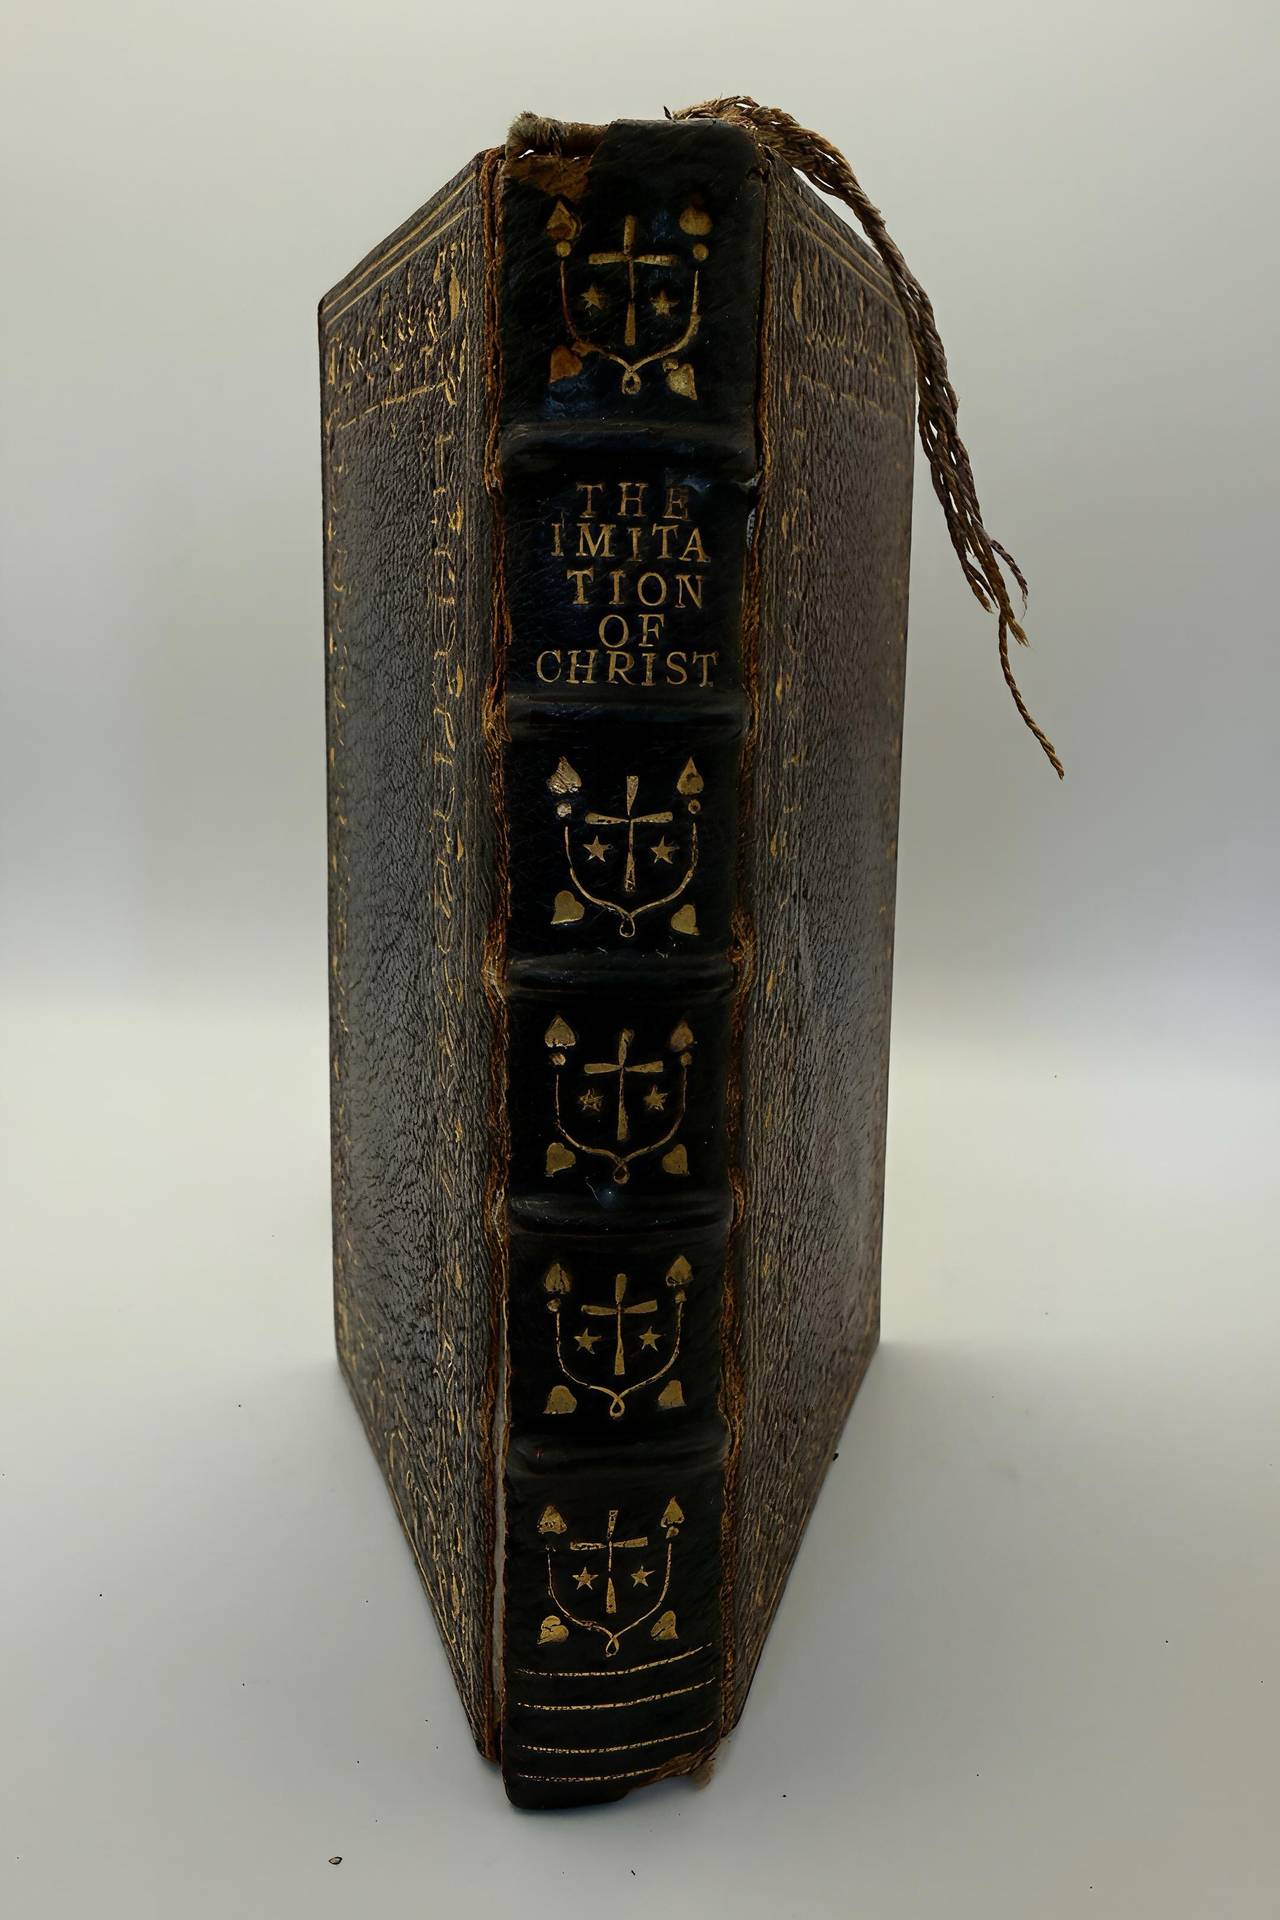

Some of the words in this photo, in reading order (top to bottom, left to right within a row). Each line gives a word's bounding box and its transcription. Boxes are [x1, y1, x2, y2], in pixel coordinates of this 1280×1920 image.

[576, 482, 690, 521] THE
[551, 523, 711, 563] IMITA
[566, 567, 704, 609] TION
[598, 613, 665, 648] OF
[536, 649, 720, 688] CHRIST
